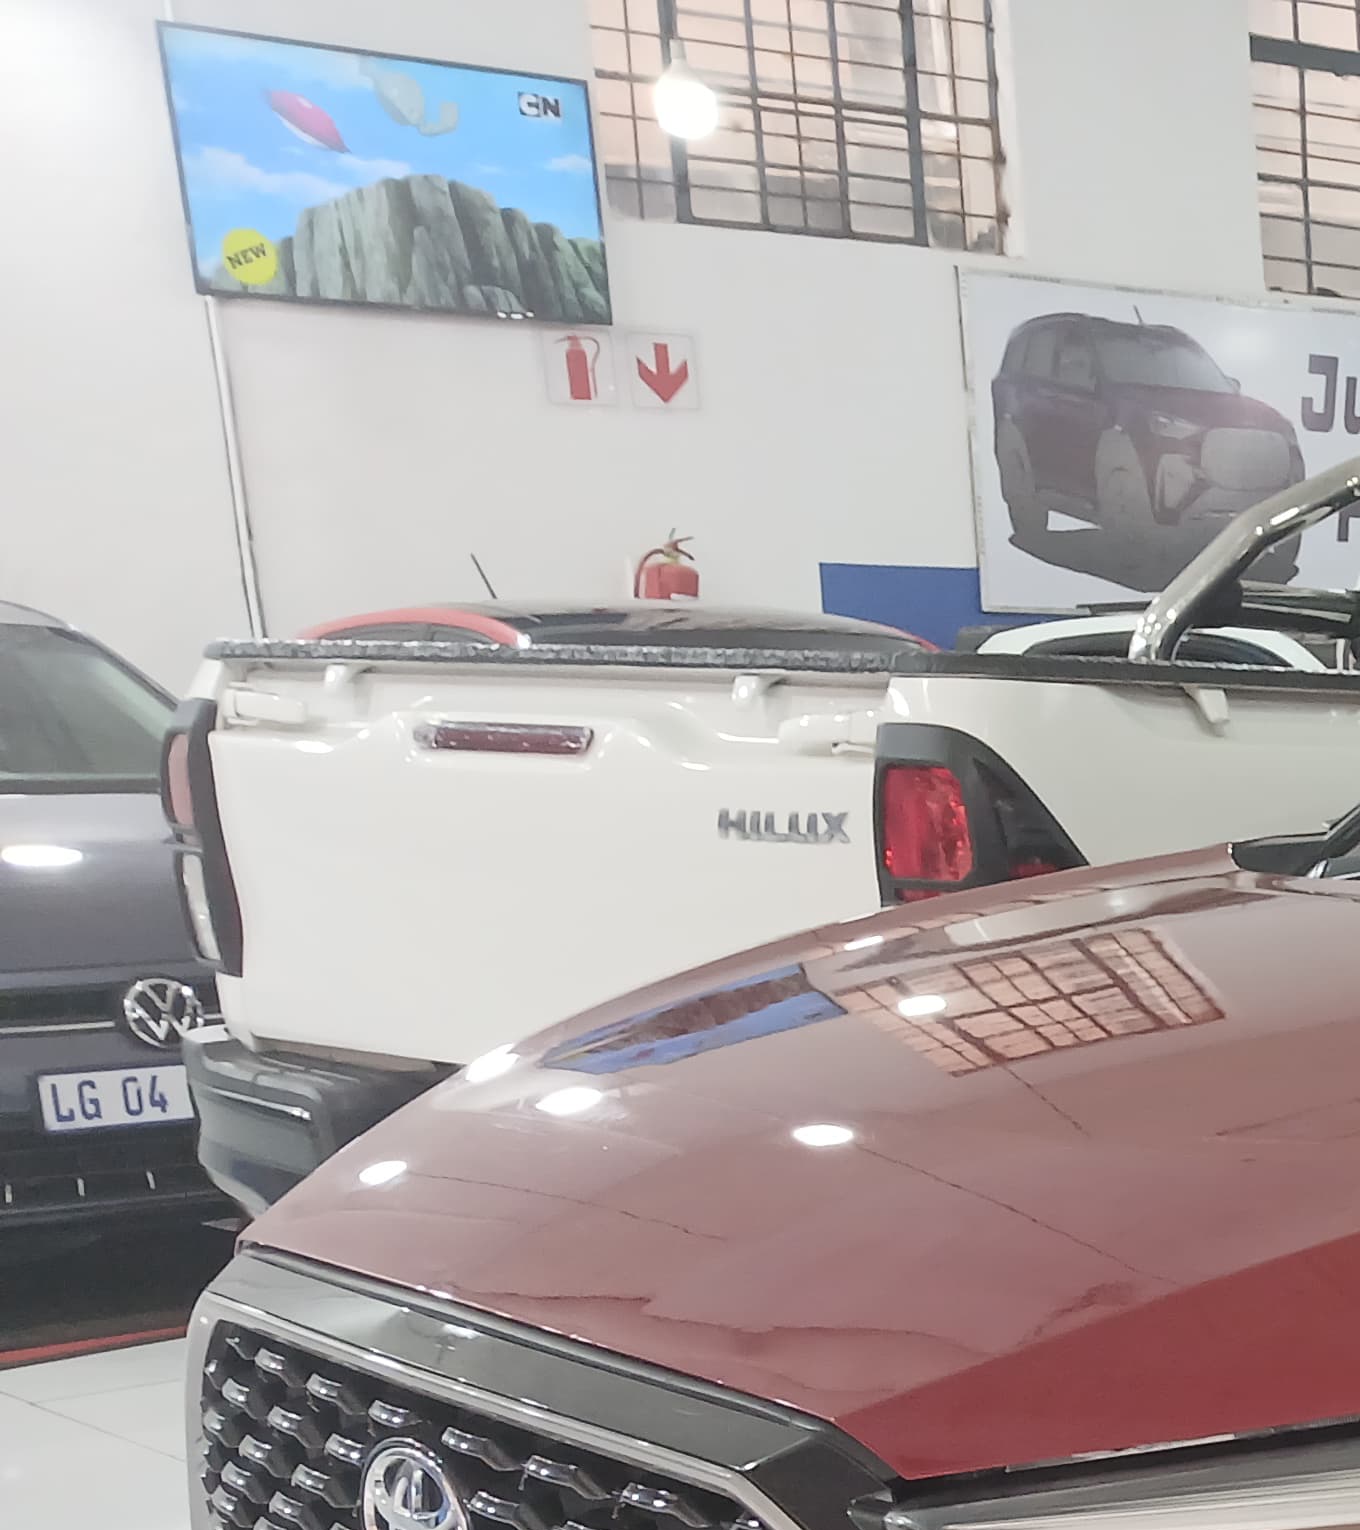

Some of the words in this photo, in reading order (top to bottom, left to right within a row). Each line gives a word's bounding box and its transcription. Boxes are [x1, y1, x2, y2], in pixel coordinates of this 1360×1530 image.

[518, 91, 561, 119] CN
[226, 243, 268, 270] NEW
[717, 808, 851, 844] HILUX
[51, 1079, 102, 1122] LG
[121, 1075, 168, 1116] 04
